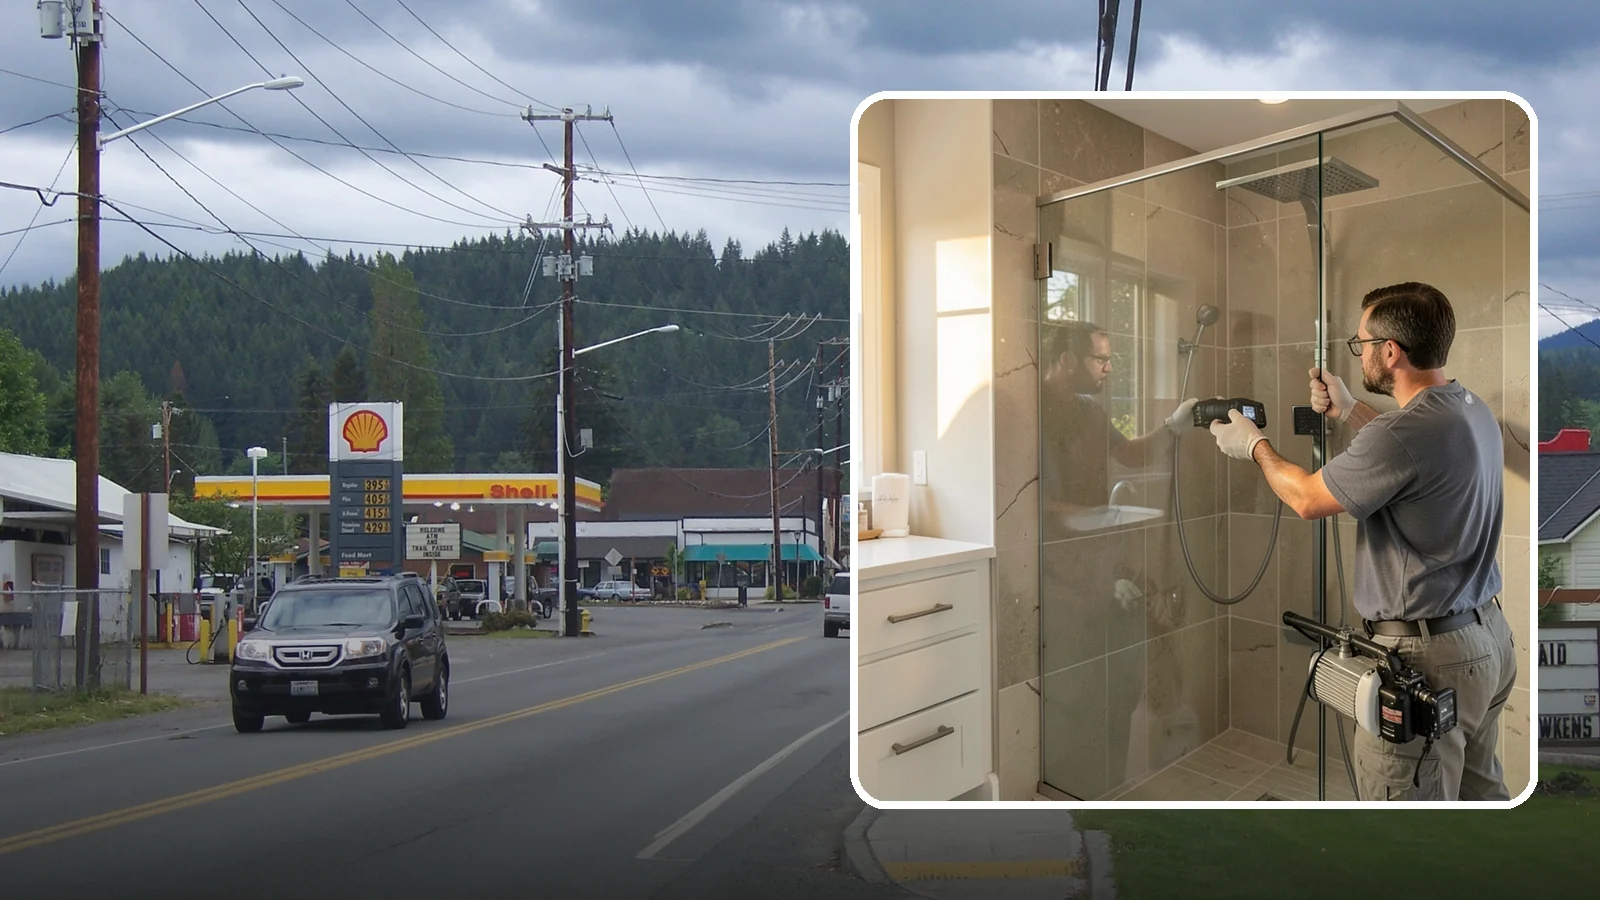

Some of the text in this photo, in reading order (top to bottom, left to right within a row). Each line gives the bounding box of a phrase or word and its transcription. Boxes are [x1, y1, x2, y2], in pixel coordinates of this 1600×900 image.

[366, 480, 383, 490] 395
[490, 484, 547, 499] Shell
[366, 494, 383, 504] 405
[366, 508, 383, 518] 415
[366, 522, 383, 532] 429
[1539, 716, 1592, 739] WKENS
